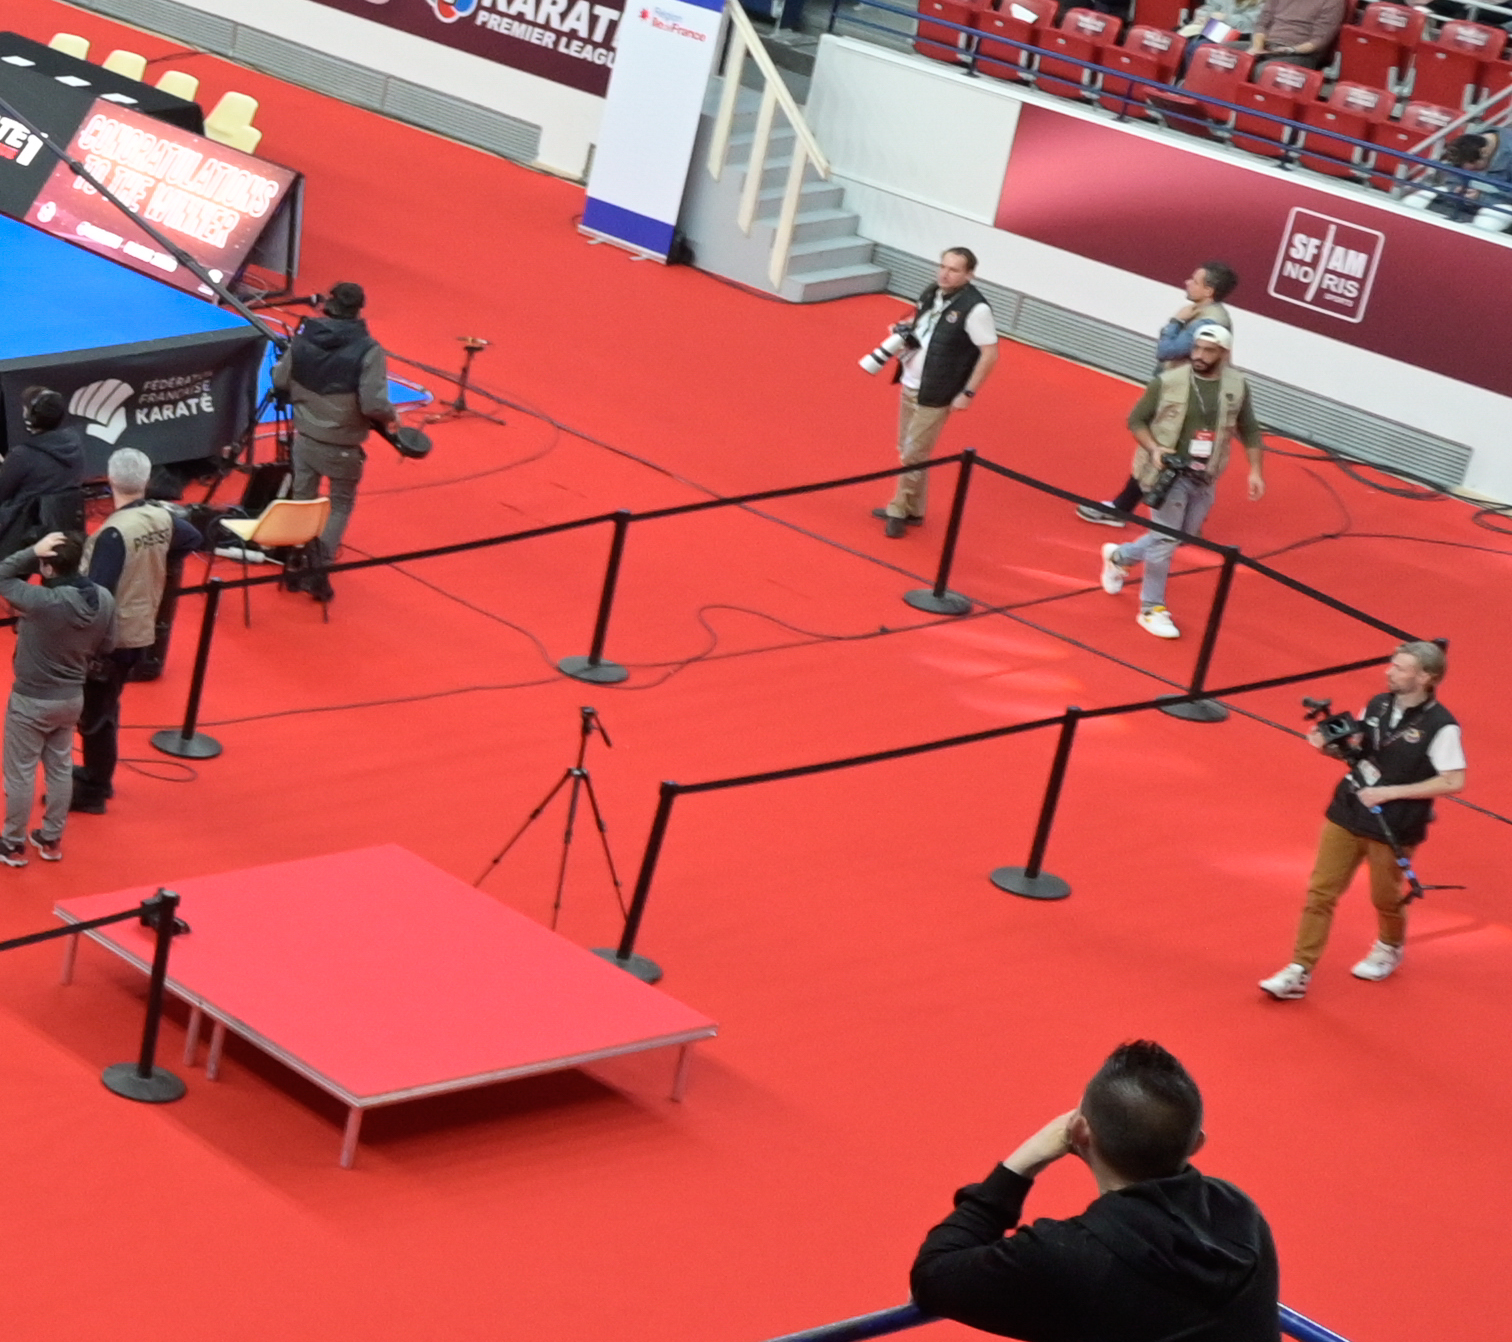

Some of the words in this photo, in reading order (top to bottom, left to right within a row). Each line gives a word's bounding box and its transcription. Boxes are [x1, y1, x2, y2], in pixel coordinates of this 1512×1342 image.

[475, 10, 555, 50] PREMIER
[557, 34, 616, 71] LEAGU
[135, 393, 215, 424] KARATÉ
